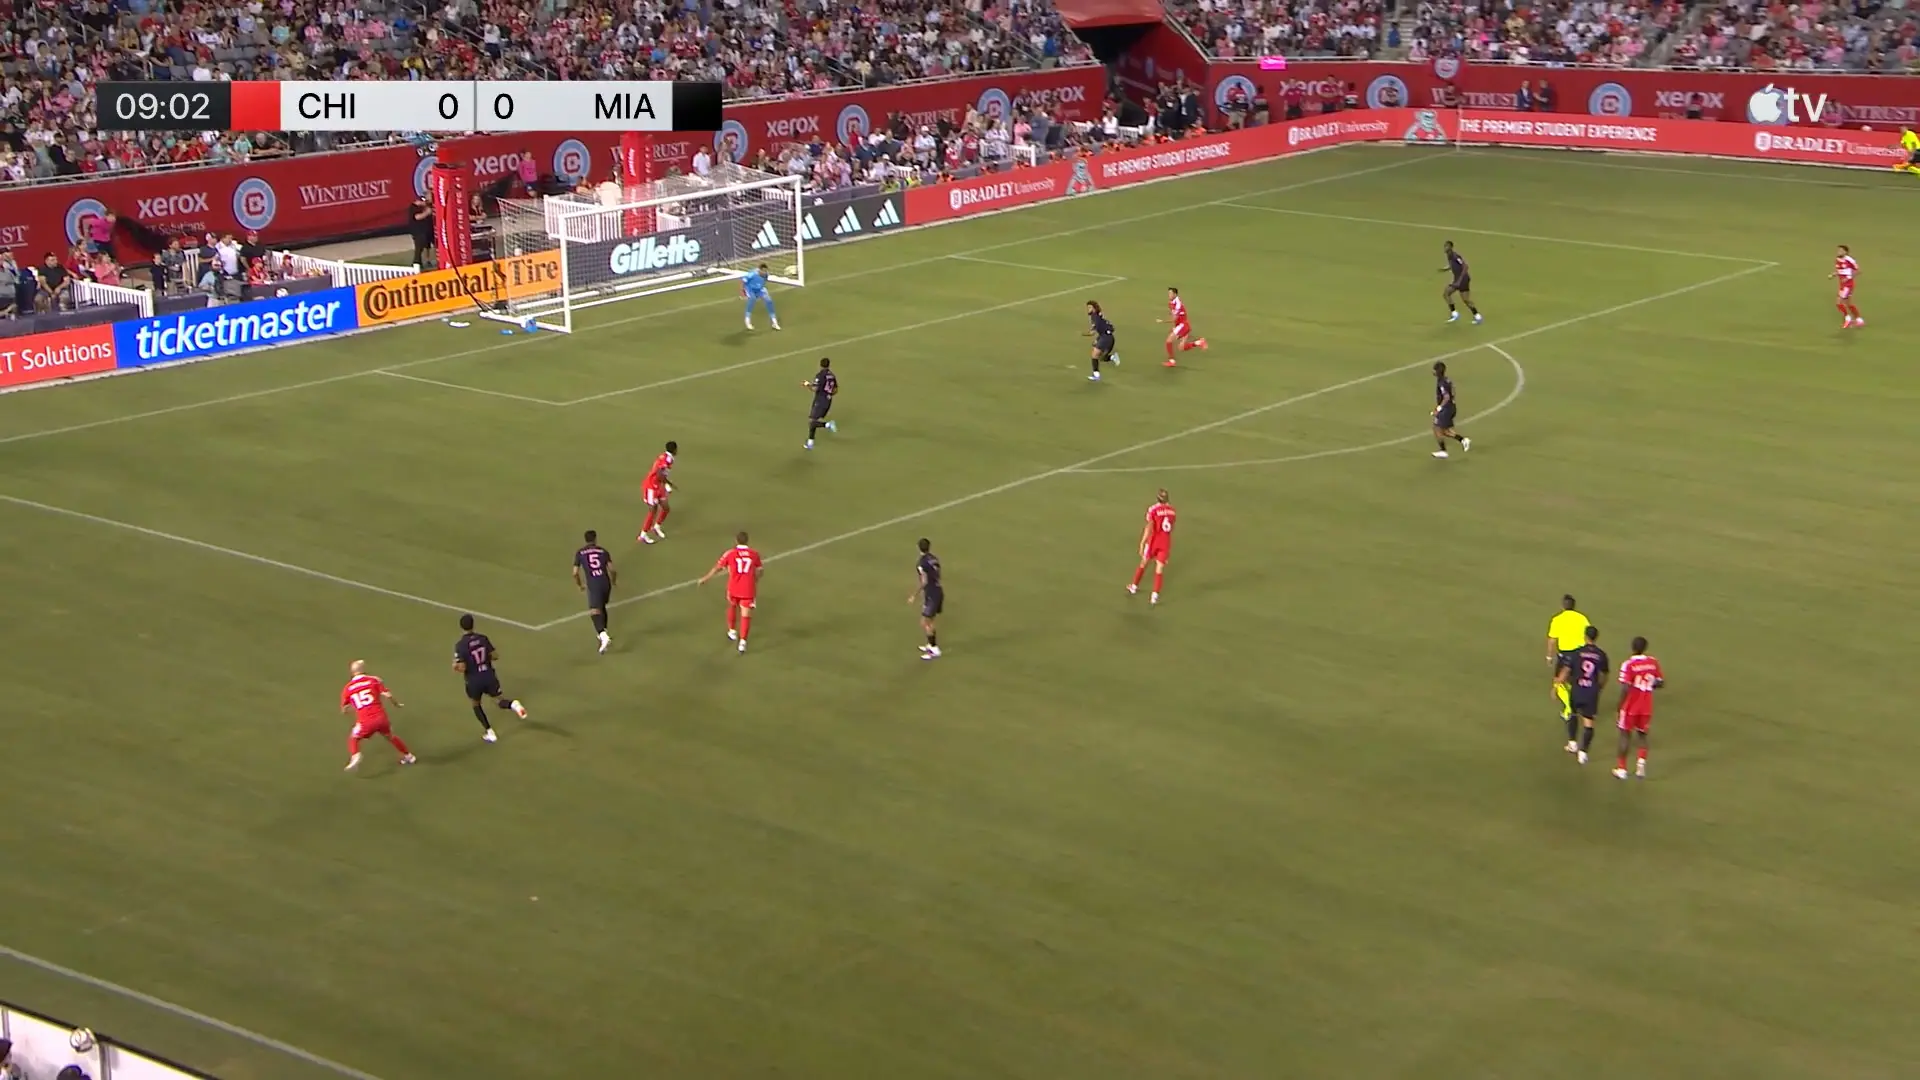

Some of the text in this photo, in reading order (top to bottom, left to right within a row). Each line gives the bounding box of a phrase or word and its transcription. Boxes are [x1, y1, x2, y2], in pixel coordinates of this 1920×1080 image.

[766, 115, 820, 138] xerox
[1300, 121, 1340, 141] BRADLEY
[1459, 119, 1658, 142] THE PREMIER STUDENT EXPERIENCE
[610, 142, 691, 164] WRUST
[1772, 135, 1846, 154] BRADLEY
[473, 153, 524, 176] xero
[1102, 141, 1232, 178] THE PREMIER STUDENT EXPERIENCE
[299, 179, 390, 205] WINTRUST
[963, 177, 1056, 204] BRADLEY University
[137, 192, 210, 219] xerox
[610, 234, 700, 275] Gillette
[364, 257, 559, 319] Continental Tire
[136, 299, 341, 360] ticketmaster
[0, 342, 112, 374] T Solutions
[1161, 516, 1171, 533] 6
[589, 553, 601, 569] 5
[735, 557, 752, 574] 17
[471, 646, 486, 665] 17
[1581, 660, 1596, 679] 9
[350, 688, 375, 710] 15
